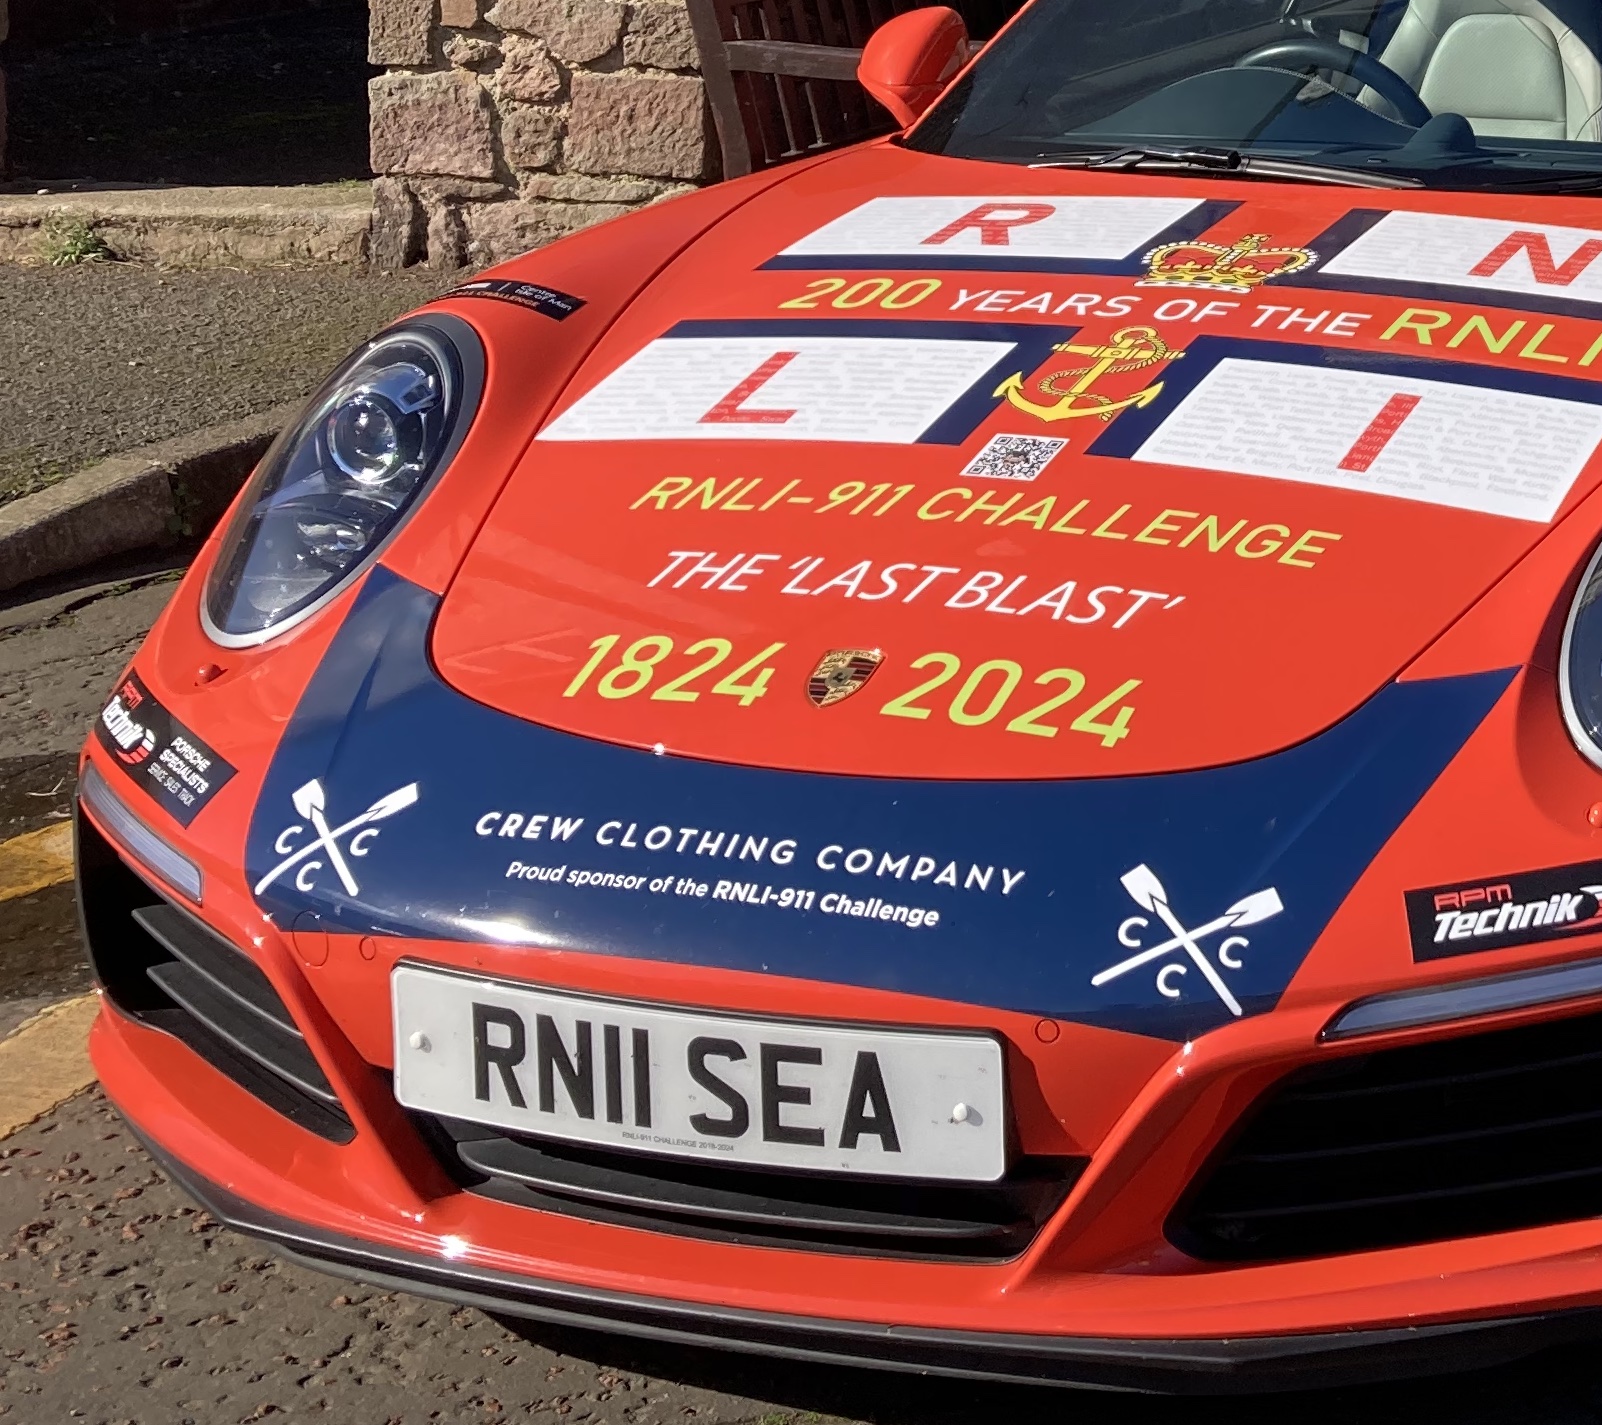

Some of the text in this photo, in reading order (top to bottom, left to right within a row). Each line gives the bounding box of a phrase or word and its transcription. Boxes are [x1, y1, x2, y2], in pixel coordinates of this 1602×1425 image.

[918, 202, 1057, 246] R
[520, 284, 557, 298] Centre
[549, 298, 572, 311] Man
[779, 277, 943, 310] 200
[947, 287, 1145, 319] YEARS
[1151, 297, 1242, 323] OF
[1248, 303, 1374, 338] THE
[695, 350, 801, 424] L
[1336, 391, 1423, 474] I
[628, 476, 1344, 570] RNLI-911 CHALLENGE
[646, 550, 1187, 629] THE 'LAST BLAST'
[562, 633, 1144, 748] 1824 2024
[159, 748, 209, 794] SPECIALISTS
[170, 736, 212, 773] PORSCHE
[275, 825, 380, 856] C C
[475, 811, 1027, 896] CREW CLOTHING COMPANY
[296, 862, 323, 892] C
[505, 860, 940, 930] Proud sponsor of the RNLI-911 Challenge
[1432, 883, 1512, 911] RPM
[1116, 916, 1250, 968] C C
[1433, 892, 1585, 943] Technik
[1156, 963, 1188, 998] C
[685, 1034, 902, 1153] SEA
